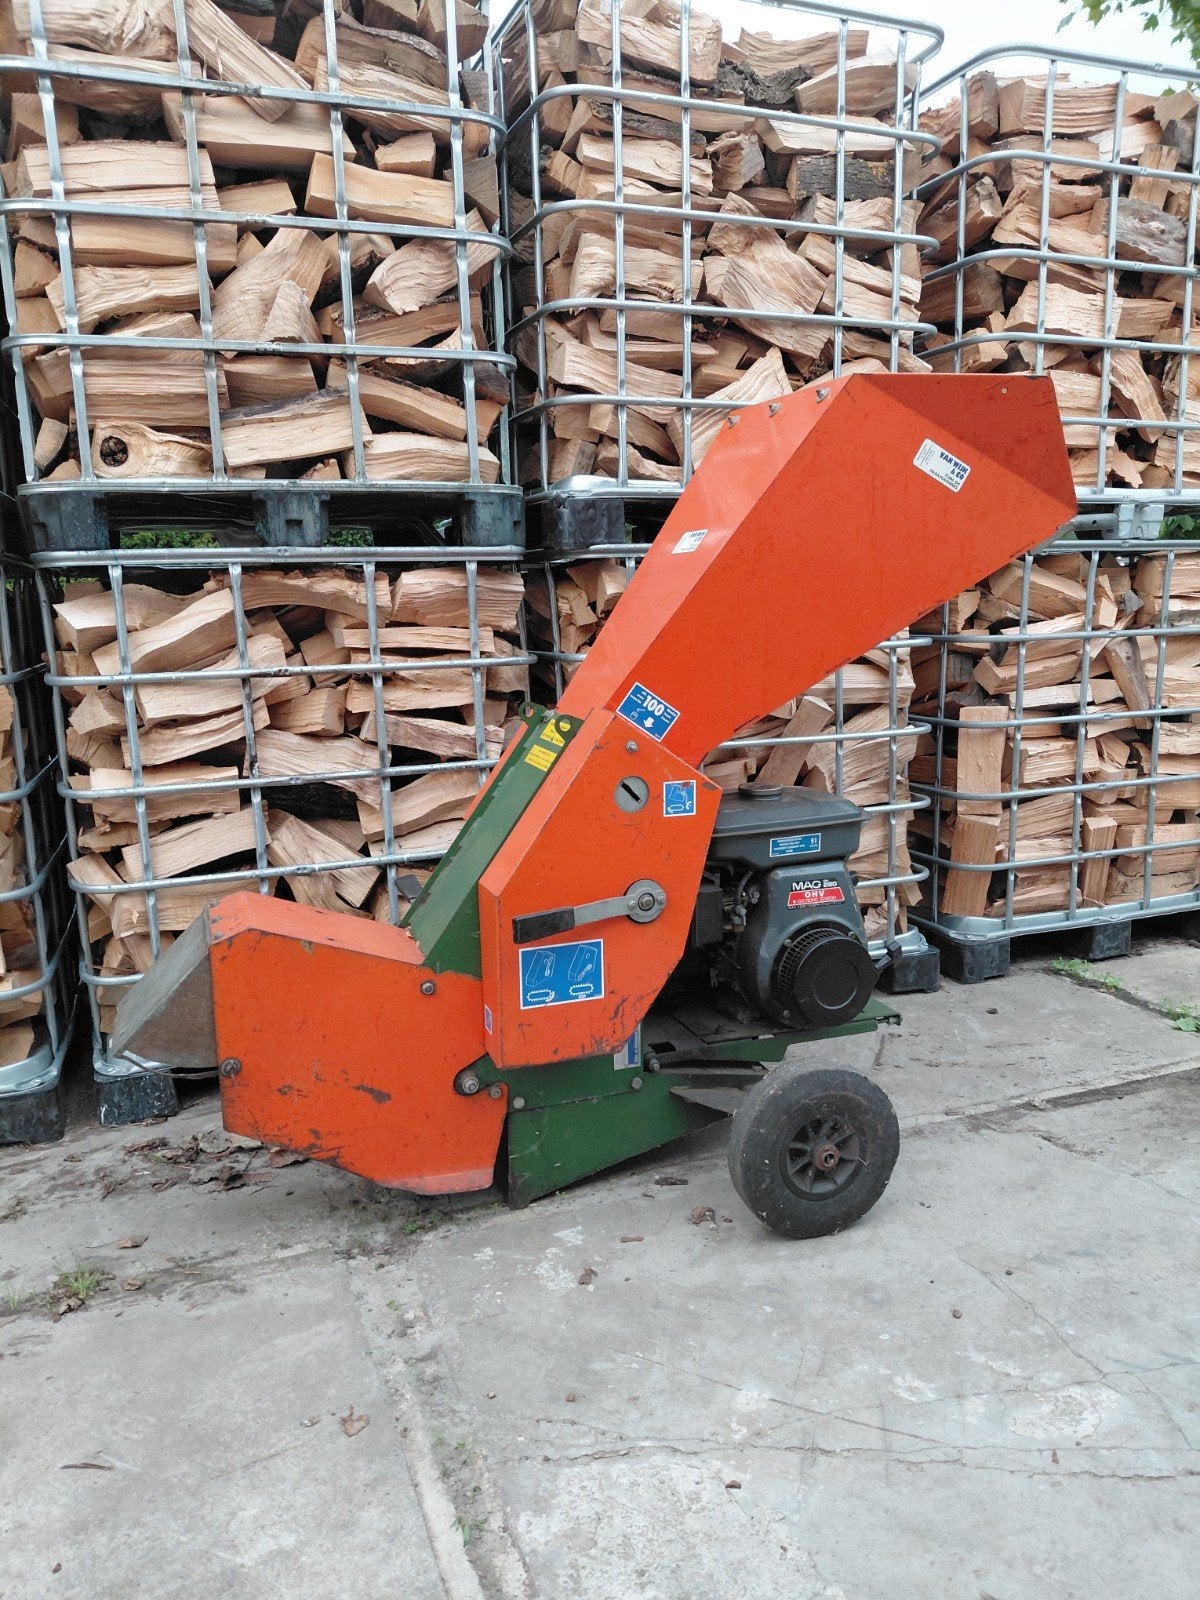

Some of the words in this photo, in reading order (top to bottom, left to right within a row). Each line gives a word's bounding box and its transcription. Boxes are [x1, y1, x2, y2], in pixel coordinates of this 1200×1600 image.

[940, 451, 954, 465] VAN
[953, 460, 968, 475] WIJK
[950, 468, 956, 476] &
[956, 471, 965, 480] CO
[642, 694, 665, 716] 100
[792, 880, 822, 891] MAG
[804, 890, 825, 898] OHV
